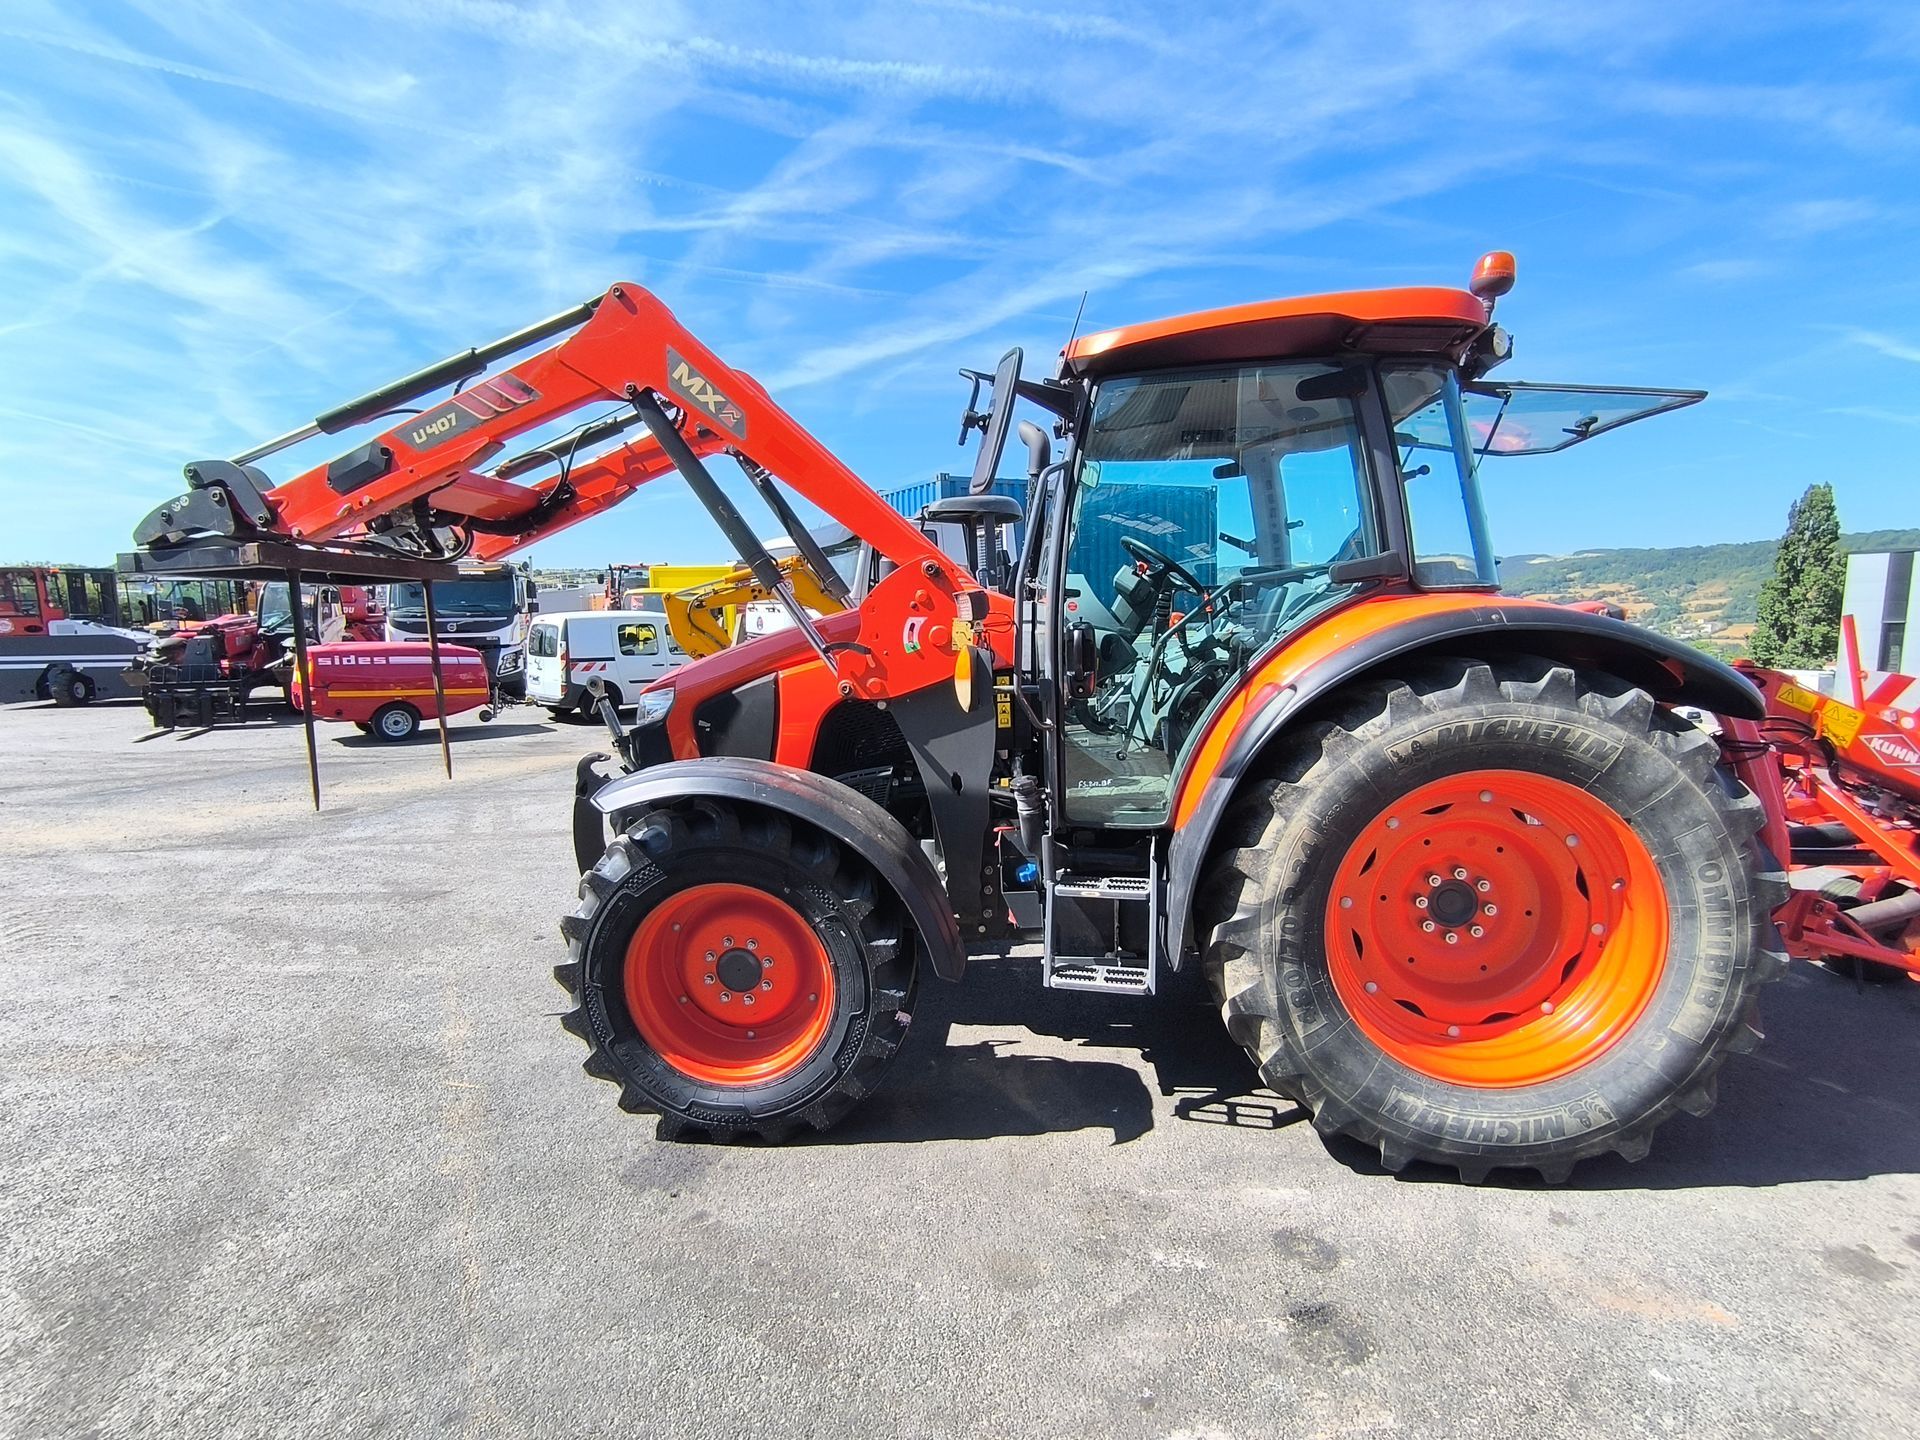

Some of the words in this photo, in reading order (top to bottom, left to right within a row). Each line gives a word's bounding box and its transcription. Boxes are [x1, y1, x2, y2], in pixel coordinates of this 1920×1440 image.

[671, 361, 727, 414] MX
[317, 655, 387, 666] sides
[1436, 718, 1622, 766] MICHELIN
[1869, 737, 1919, 765] KUHN
[1693, 860, 1733, 1010] OMNIBIB
[1386, 1099, 1566, 1144] MICHELIN
